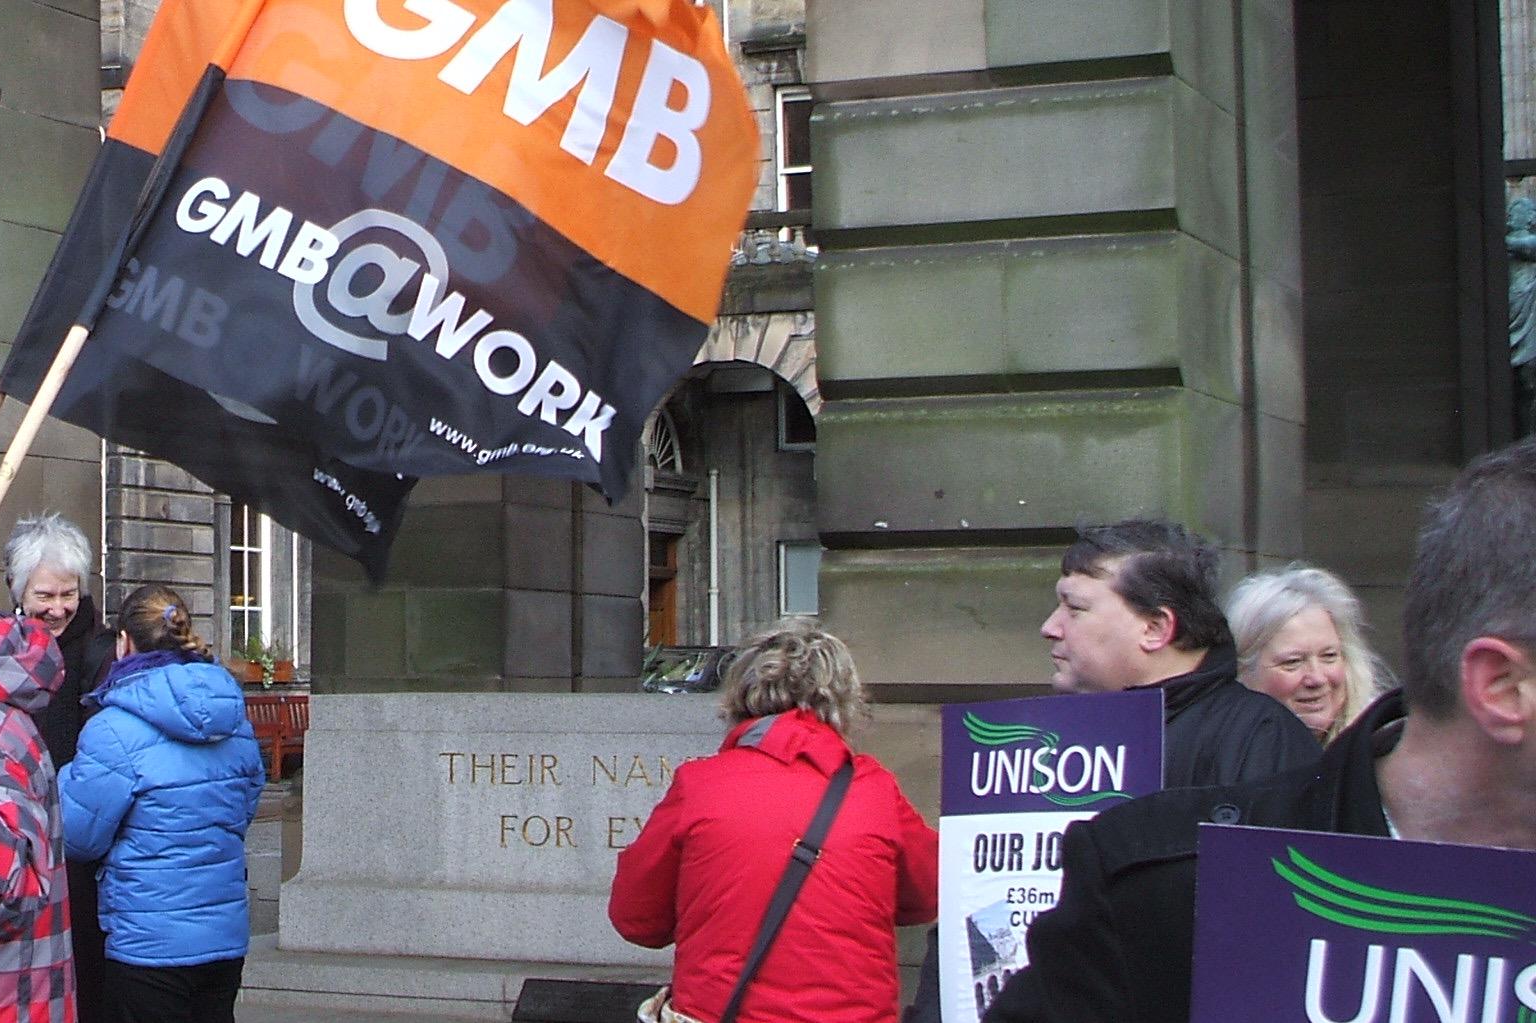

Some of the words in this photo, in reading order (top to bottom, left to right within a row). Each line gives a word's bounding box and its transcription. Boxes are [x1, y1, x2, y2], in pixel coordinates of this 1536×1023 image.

[343, 0, 712, 206] GMB
[439, 753, 562, 786] THEIR
[591, 755, 711, 787] NA
[971, 745, 1126, 797] UNISON
[499, 815, 579, 848] FOR
[973, 833, 1025, 874] OUR
[1006, 887, 1055, 904] £36m
